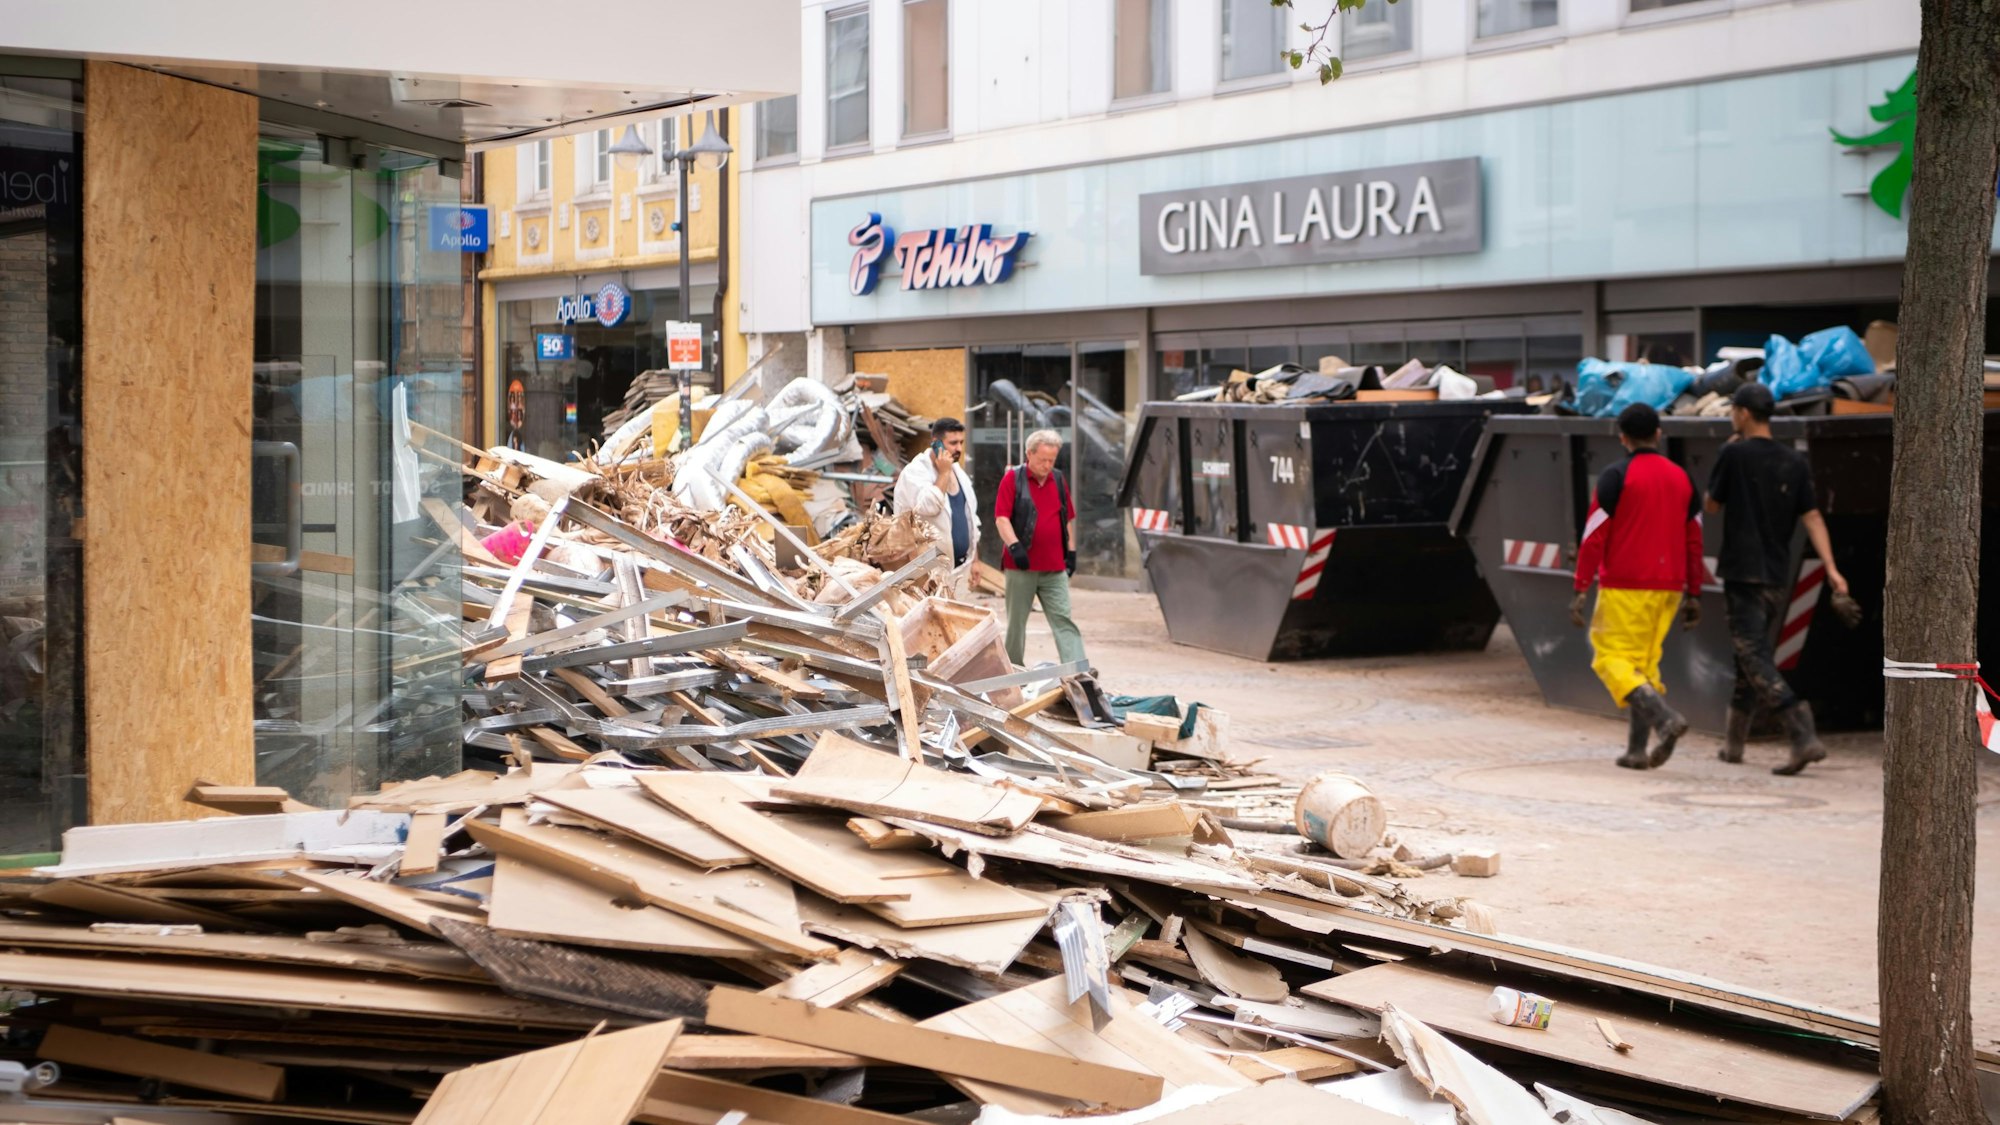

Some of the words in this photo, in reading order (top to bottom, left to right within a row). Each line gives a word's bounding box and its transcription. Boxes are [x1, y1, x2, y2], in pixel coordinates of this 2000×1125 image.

[1157, 195, 1262, 254] GINA
[1273, 176, 1442, 244] LAURA
[441, 233, 481, 248] Apollo
[895, 224, 1029, 290] Tchibo
[556, 294, 590, 326] Apollo
[1270, 456, 1295, 484] 744
